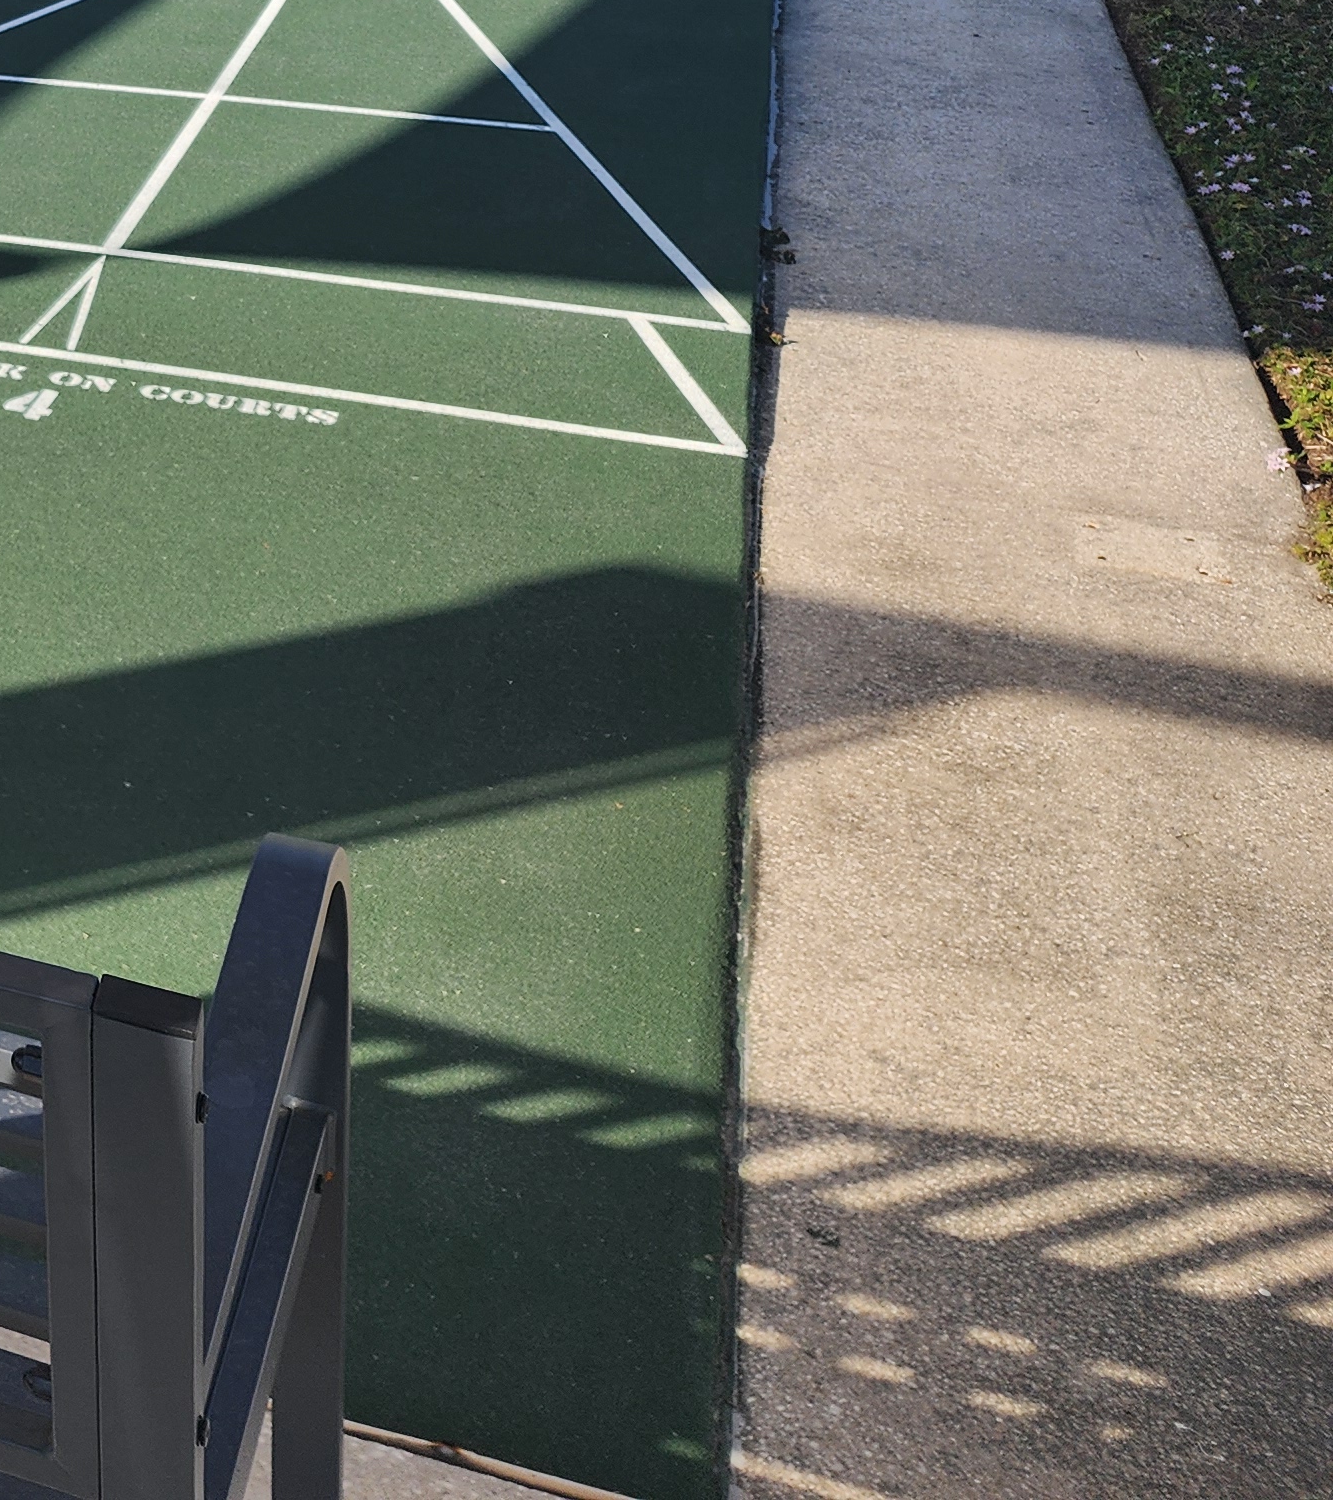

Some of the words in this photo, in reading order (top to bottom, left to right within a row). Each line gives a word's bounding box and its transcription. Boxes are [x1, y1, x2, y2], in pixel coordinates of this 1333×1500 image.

[1, 387, 61, 422] 4
[47, 370, 119, 393] ON
[138, 383, 341, 426] COURTS
